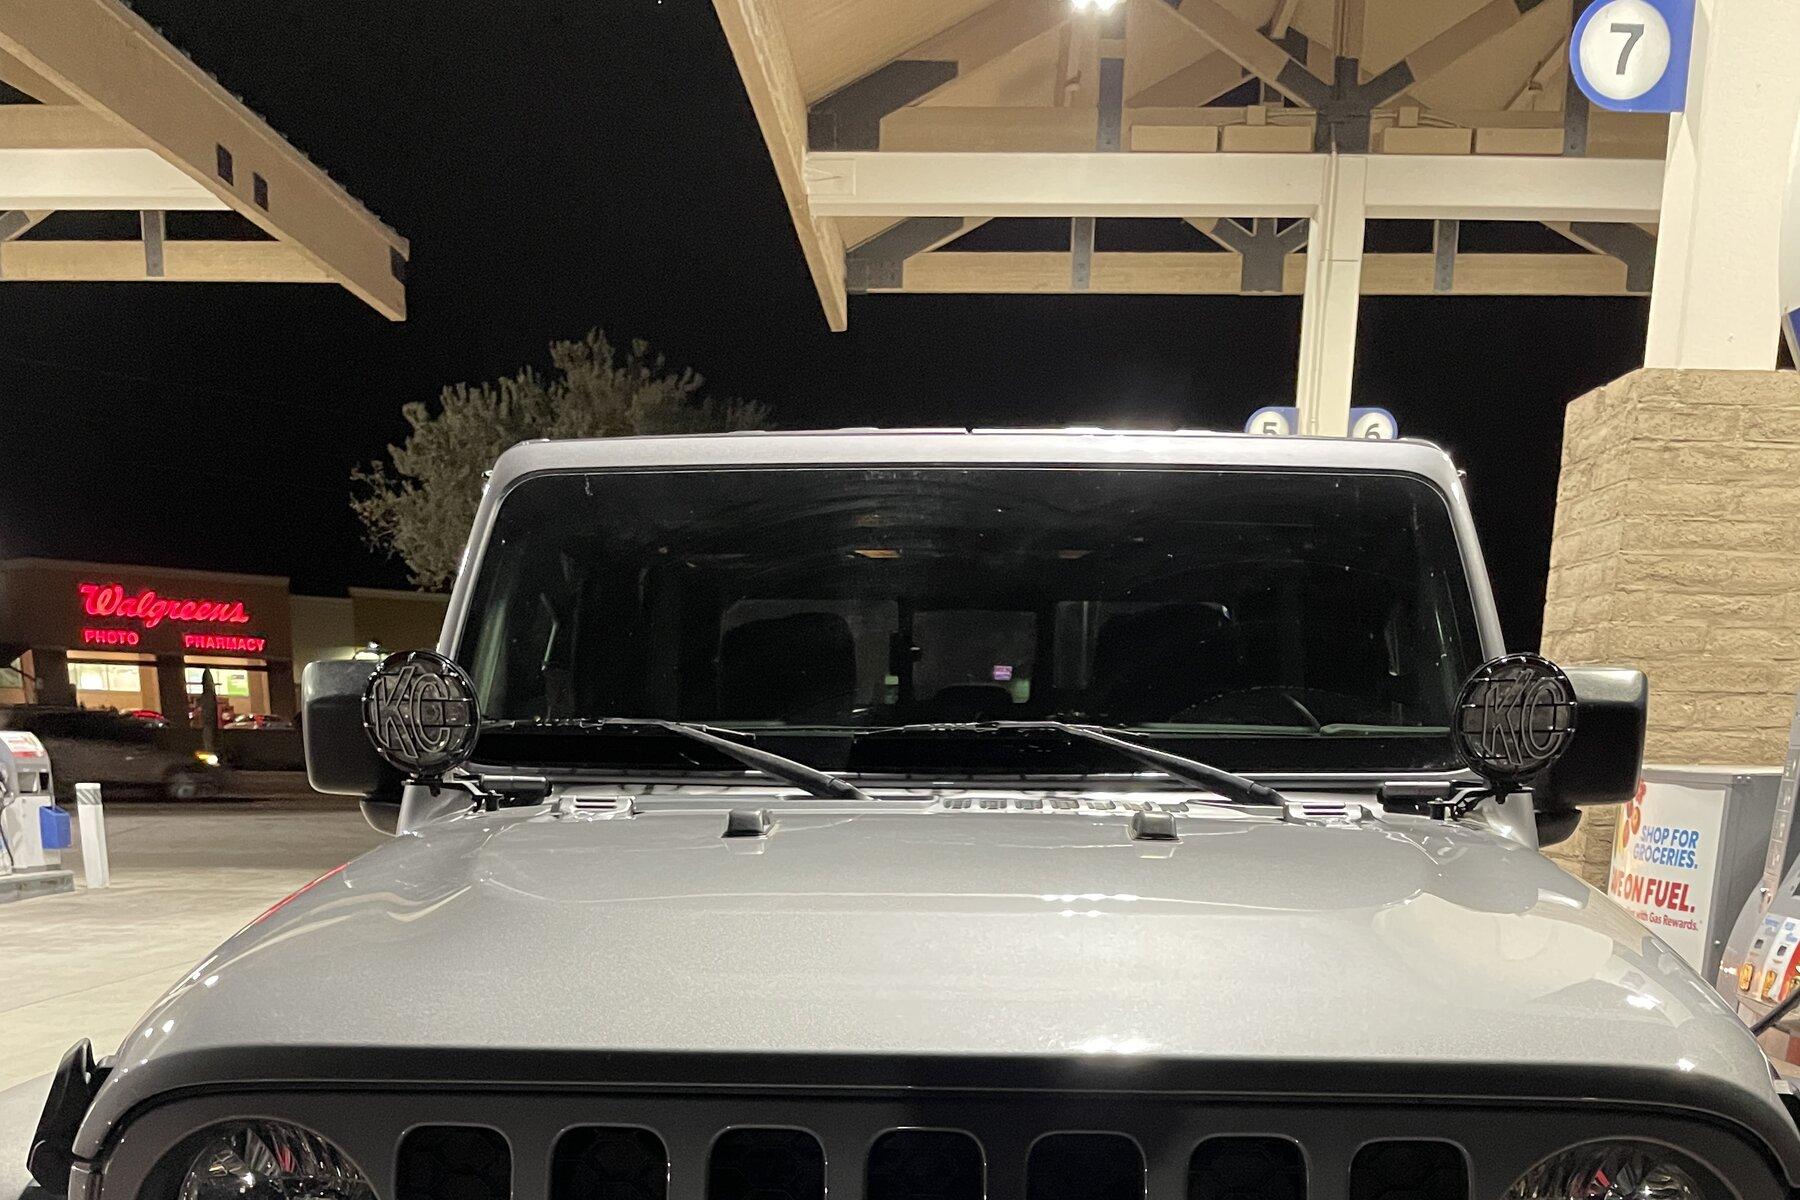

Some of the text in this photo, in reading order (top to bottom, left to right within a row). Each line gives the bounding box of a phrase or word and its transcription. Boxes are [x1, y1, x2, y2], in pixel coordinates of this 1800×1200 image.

[1609, 23, 1645, 76] 7
[80, 584, 249, 628] Walgreens
[84, 630, 139, 645] PHOTO
[184, 634, 266, 651] PHARMACY
[373, 665, 451, 759] KC
[1482, 668, 1566, 766] KC
[1641, 825, 1699, 849] SHOP FOR
[1633, 842, 1698, 869] GROCERIES.
[1624, 873, 1645, 903] ON
[1644, 878, 1696, 913] FUEL.
[1649, 911, 1662, 925] Gas
